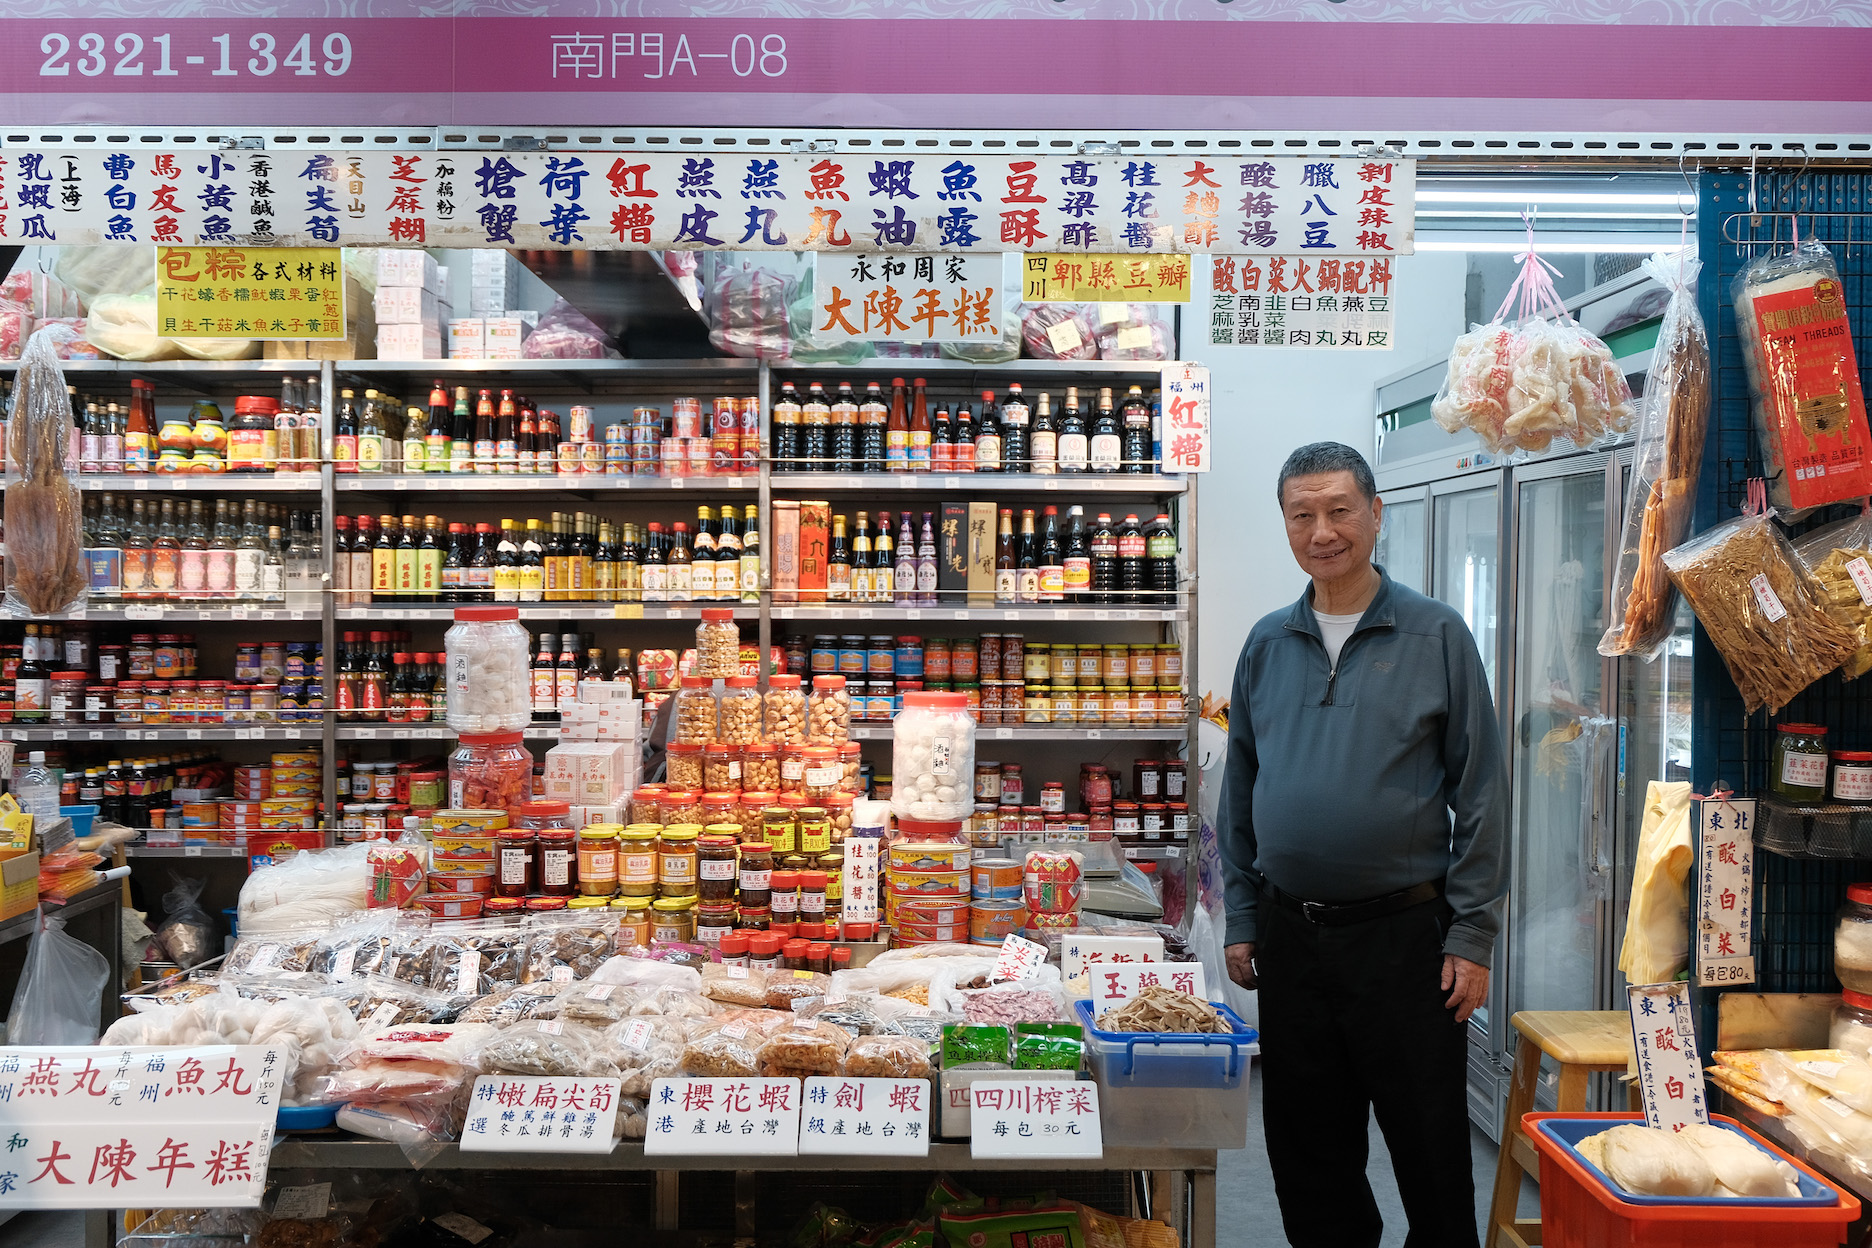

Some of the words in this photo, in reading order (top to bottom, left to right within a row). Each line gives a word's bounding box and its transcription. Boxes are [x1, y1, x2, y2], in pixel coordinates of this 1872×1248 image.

[39, 32, 353, 77] 2321-1349
[59, 155, 82, 212] (上海)
[103, 153, 137, 242] 曹白魚
[148, 154, 186, 243] 馬友魚
[346, 157, 366, 218] (天目山)
[385, 155, 428, 243] 芝麻糊
[539, 156, 590, 245] 荷葉
[605, 157, 659, 244] 紅糟
[673, 158, 726, 246] 燕皮
[737, 158, 788, 246] 燕丸
[802, 159, 852, 247] 魚丸
[867, 160, 920, 247] 蝦油
[936, 160, 983, 247] 魚露
[999, 161, 1048, 248] 豆酥
[1119, 161, 1161, 249] 桂花醬
[1238, 161, 1280, 248] 酸梅湯
[158, 247, 247, 283] 包粽
[250, 261, 337, 282] 各式材料
[851, 254, 968, 283] 永和周家
[1027, 258, 1048, 299] 四川
[1212, 258, 1393, 295] 酸白菜火鍋配料
[820, 285, 999, 339] 大陳年糕
[1802, 325, 1845, 342] THREADS
[1169, 382, 1204, 393] 福州
[1168, 395, 1203, 467] 紅糟
[1709, 810, 1749, 831] 東北
[851, 844, 863, 900] 桂花醬
[1716, 842, 1738, 956] 酸白菜
[1703, 965, 1750, 982] 每包80元
[17, 1056, 108, 1098] 燕丸
[139, 1054, 166, 1103] 福州
[164, 1056, 252, 1098] 魚丸
[496, 1082, 616, 1112] 嫩扁尖筍
[682, 1083, 792, 1112] 櫻花蝦
[834, 1082, 922, 1113] 劍蝦
[974, 1086, 1094, 1115] 四川榨菜
[468, 1084, 497, 1134] 特選
[497, 1125, 594, 1138] 冬瓜排骨湯
[656, 1085, 675, 1134] 東港
[692, 1118, 779, 1136] 產地台灣
[808, 1086, 829, 1134] 特級
[831, 1120, 923, 1139] 產地台灣
[991, 1120, 1081, 1138] 每包30元
[27, 1137, 254, 1189] 大陳年糕
